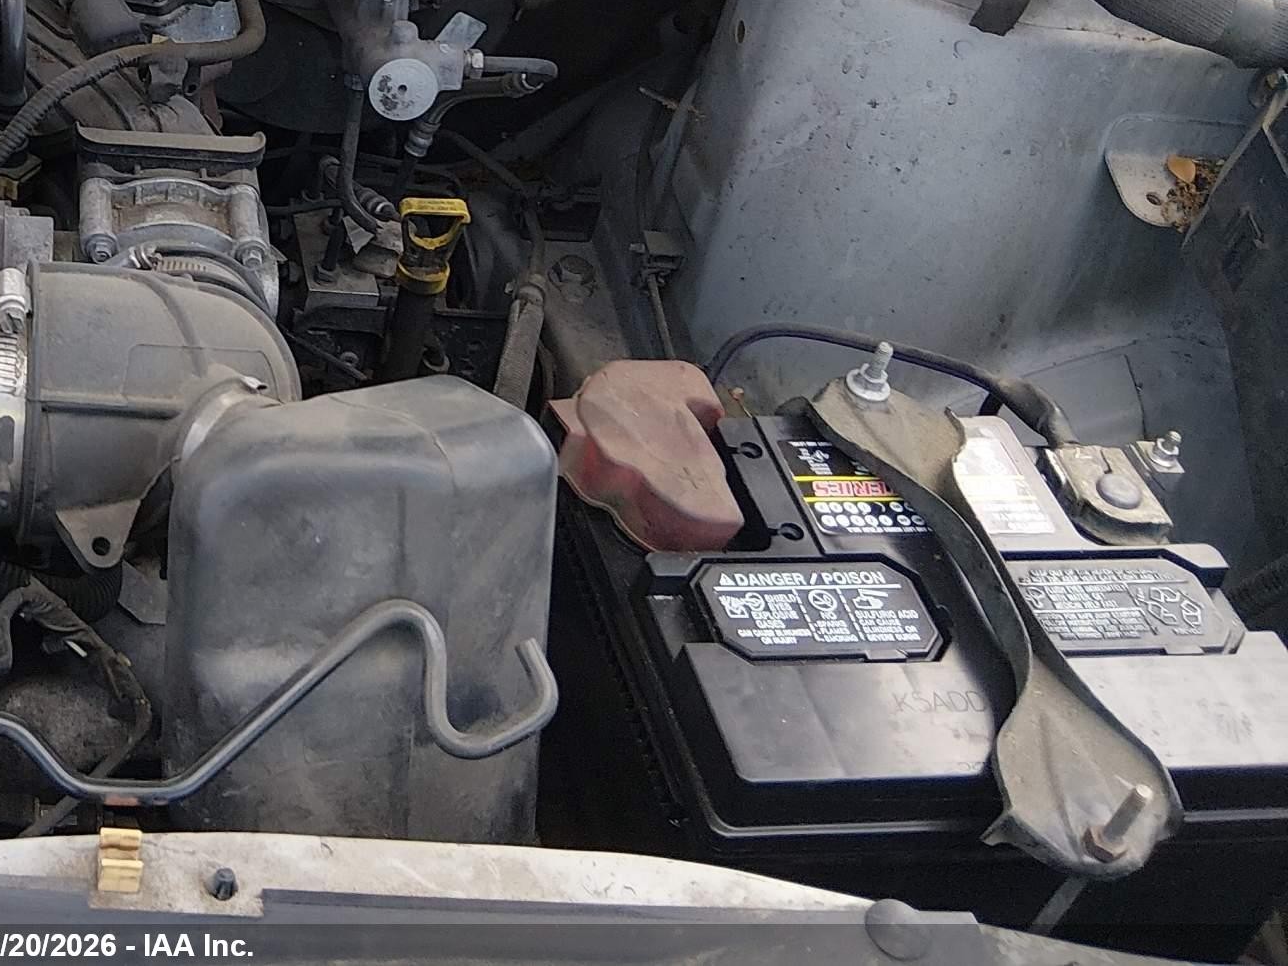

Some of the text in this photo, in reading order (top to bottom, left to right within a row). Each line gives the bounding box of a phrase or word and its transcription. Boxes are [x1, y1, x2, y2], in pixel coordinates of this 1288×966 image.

[733, 572, 807, 586] DANGER
[823, 571, 886, 585] POISON
[763, 593, 797, 603] SHIELD
[769, 602, 793, 611] EYES
[751, 611, 800, 620] EXPLOSIVE
[820, 611, 837, 620] NO
[854, 609, 919, 619] SULFURIC ACID
[858, 618, 902, 627] CAN CAUSE
